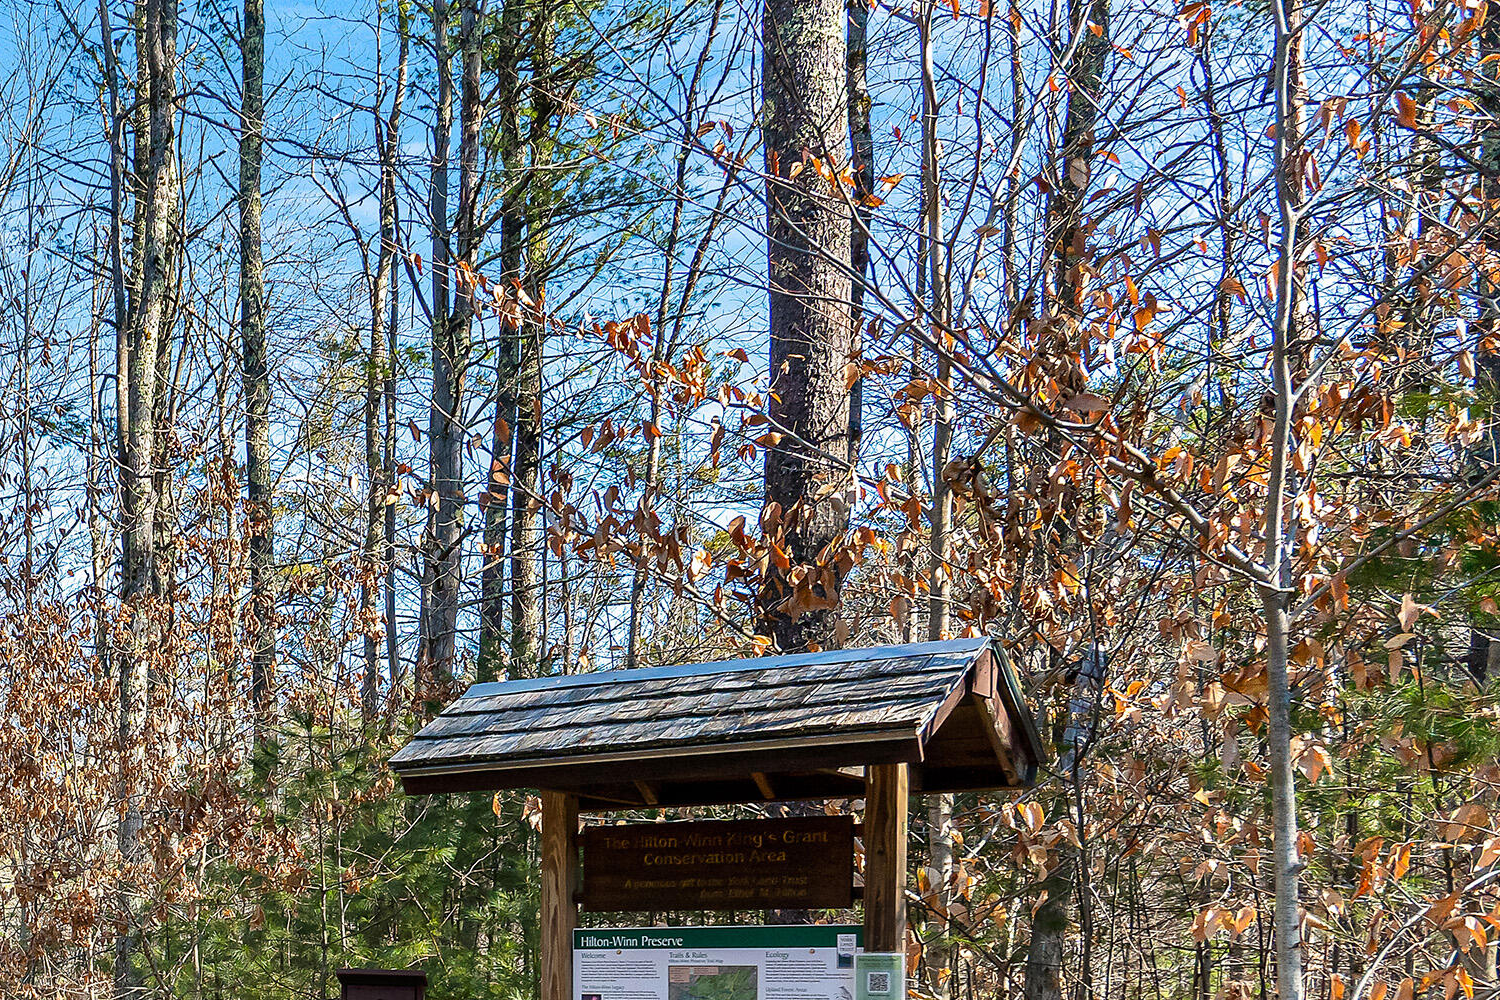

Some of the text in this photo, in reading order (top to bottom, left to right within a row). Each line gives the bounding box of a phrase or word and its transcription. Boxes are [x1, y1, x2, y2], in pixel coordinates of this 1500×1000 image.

[782, 829, 828, 844] Grant
[643, 849, 787, 866] Conservation Area
[580, 935, 684, 947] Hilton-Winn Preserve
[765, 951, 789, 960] Ecology
